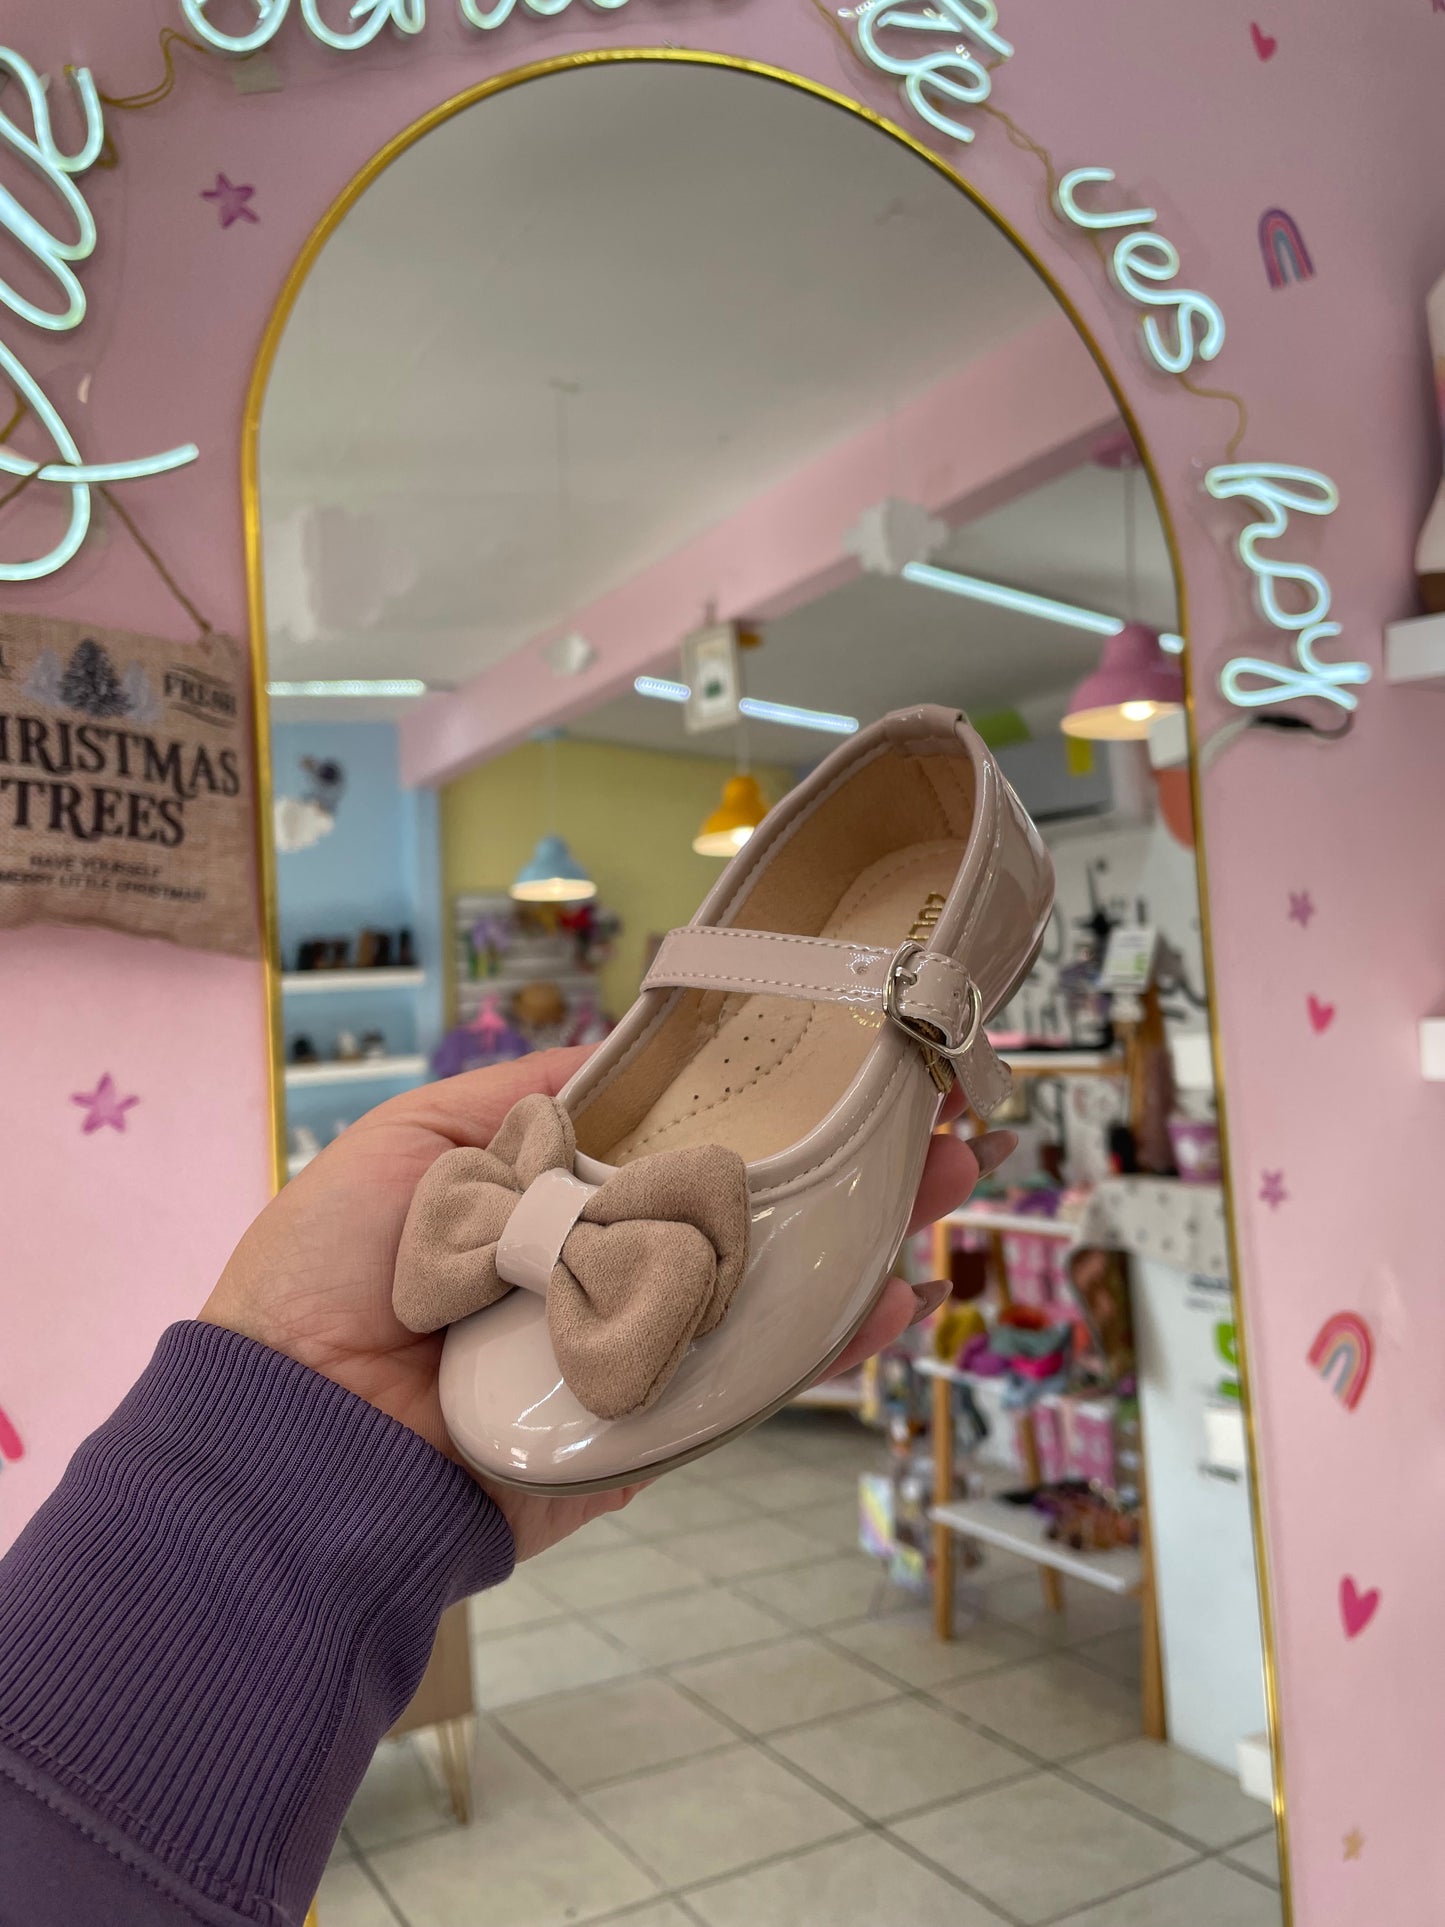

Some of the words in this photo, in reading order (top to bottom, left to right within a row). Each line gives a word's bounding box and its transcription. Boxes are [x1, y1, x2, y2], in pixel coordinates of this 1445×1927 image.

[1057, 167, 1226, 373] ves
[1204, 462, 1372, 711] hoy
[0, 778, 185, 848] TREES
